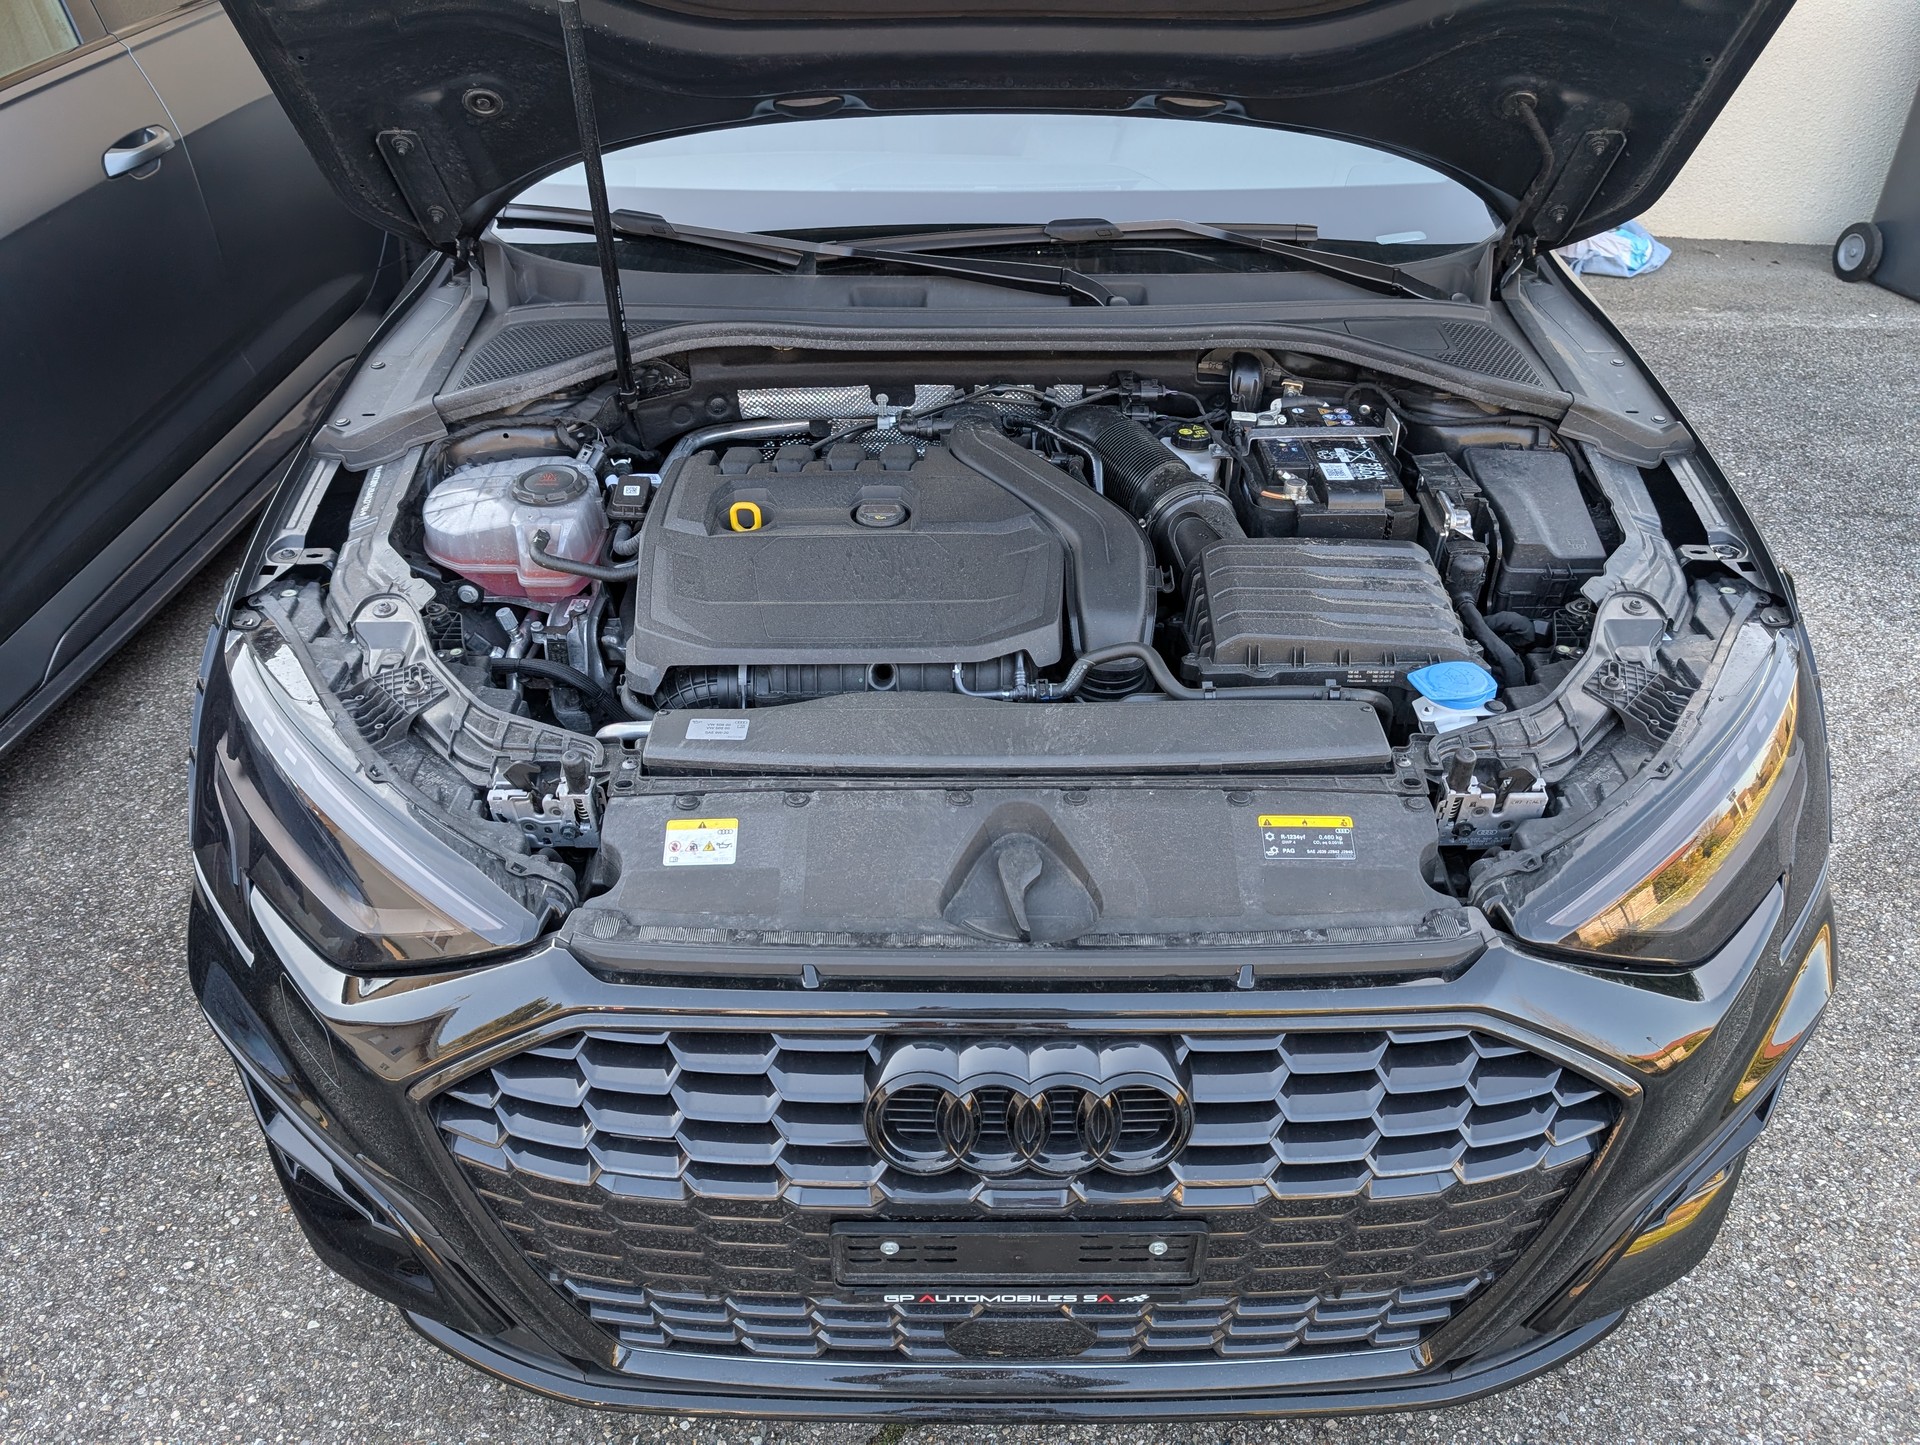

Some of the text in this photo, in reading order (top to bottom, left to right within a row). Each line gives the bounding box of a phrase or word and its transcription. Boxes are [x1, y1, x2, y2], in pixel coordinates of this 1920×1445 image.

[883, 1293, 1115, 1303] GP AUTOMOBILES SA
